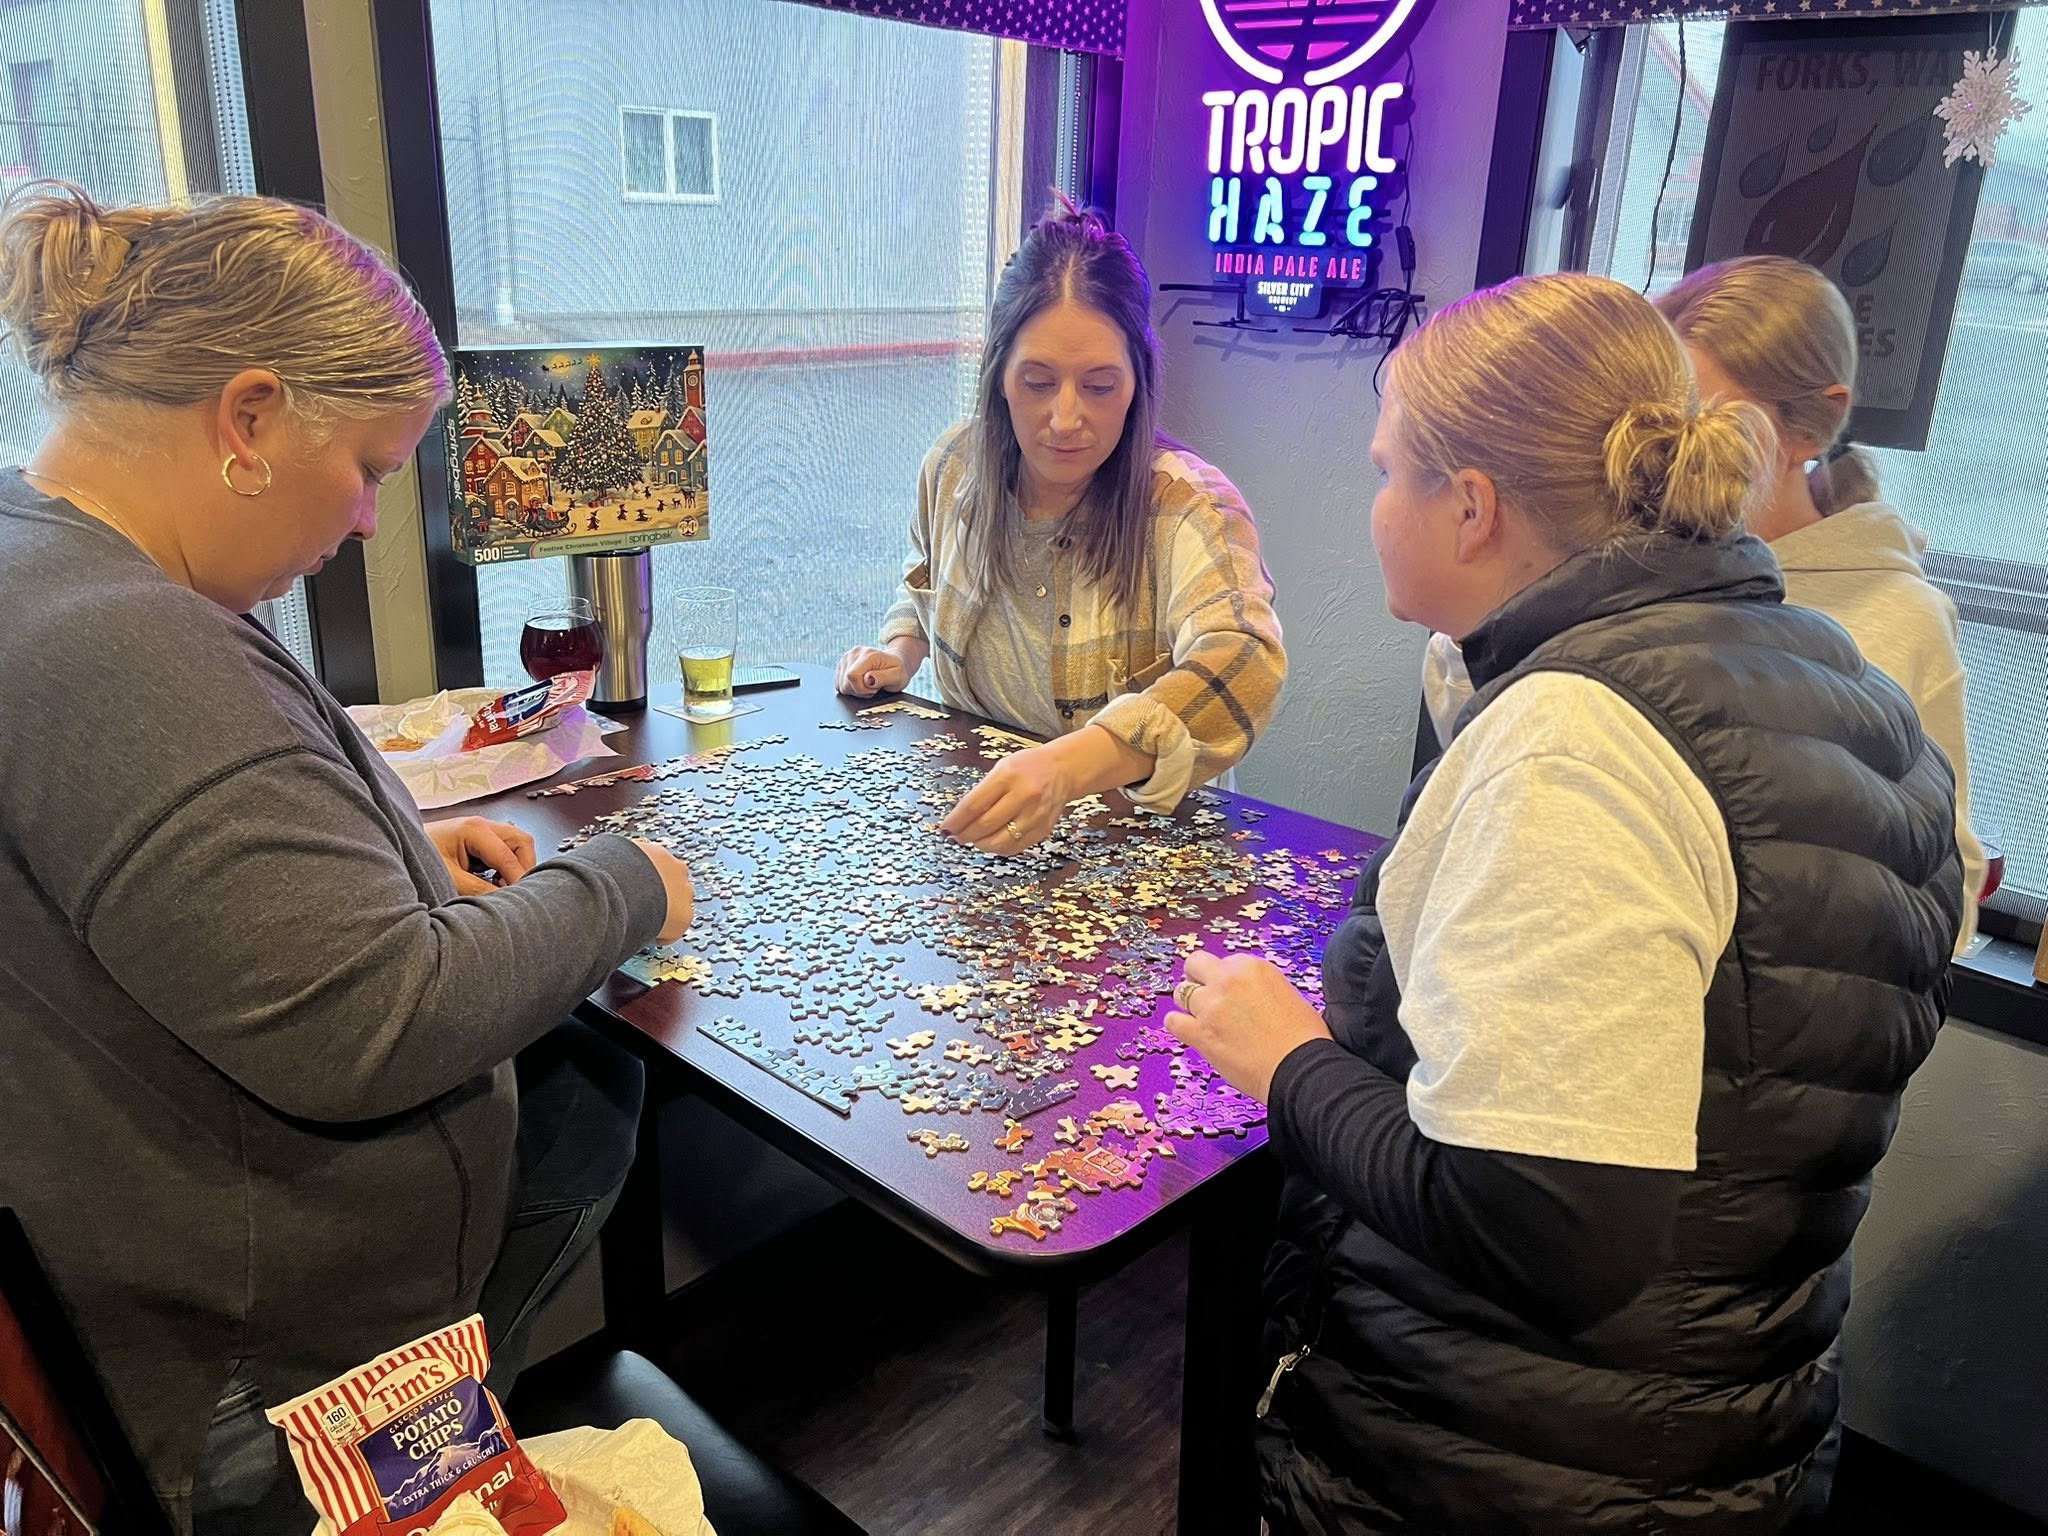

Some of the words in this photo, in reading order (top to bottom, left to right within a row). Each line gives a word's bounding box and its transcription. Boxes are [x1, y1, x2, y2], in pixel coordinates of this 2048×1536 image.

[1756, 52, 1878, 95] FORKS,
[1202, 82, 1403, 174] TROPIC
[1208, 176, 1377, 246] HAZE
[1215, 252, 1264, 275] INDIA
[1273, 255, 1318, 278] PALE
[1326, 257, 1361, 280] ALE
[1257, 281, 1288, 296] SILVER
[448, 418, 463, 501] springbok
[474, 547, 500, 563] 500
[539, 545, 562, 553] Festive
[565, 541, 598, 551] Christmas
[600, 538, 622, 548] Village
[629, 531, 673, 544] springbok
[372, 1364, 446, 1414] Tim's
[325, 1407, 347, 1425] 160
[389, 1404, 425, 1434] CASCADE
[428, 1391, 455, 1406] STYLE
[391, 1398, 462, 1450] POTATO
[409, 1418, 464, 1460] CHIPS
[402, 1486, 430, 1506] EXTRA
[429, 1471, 454, 1490] THICK
[462, 1445, 496, 1470] CRUNCHY
